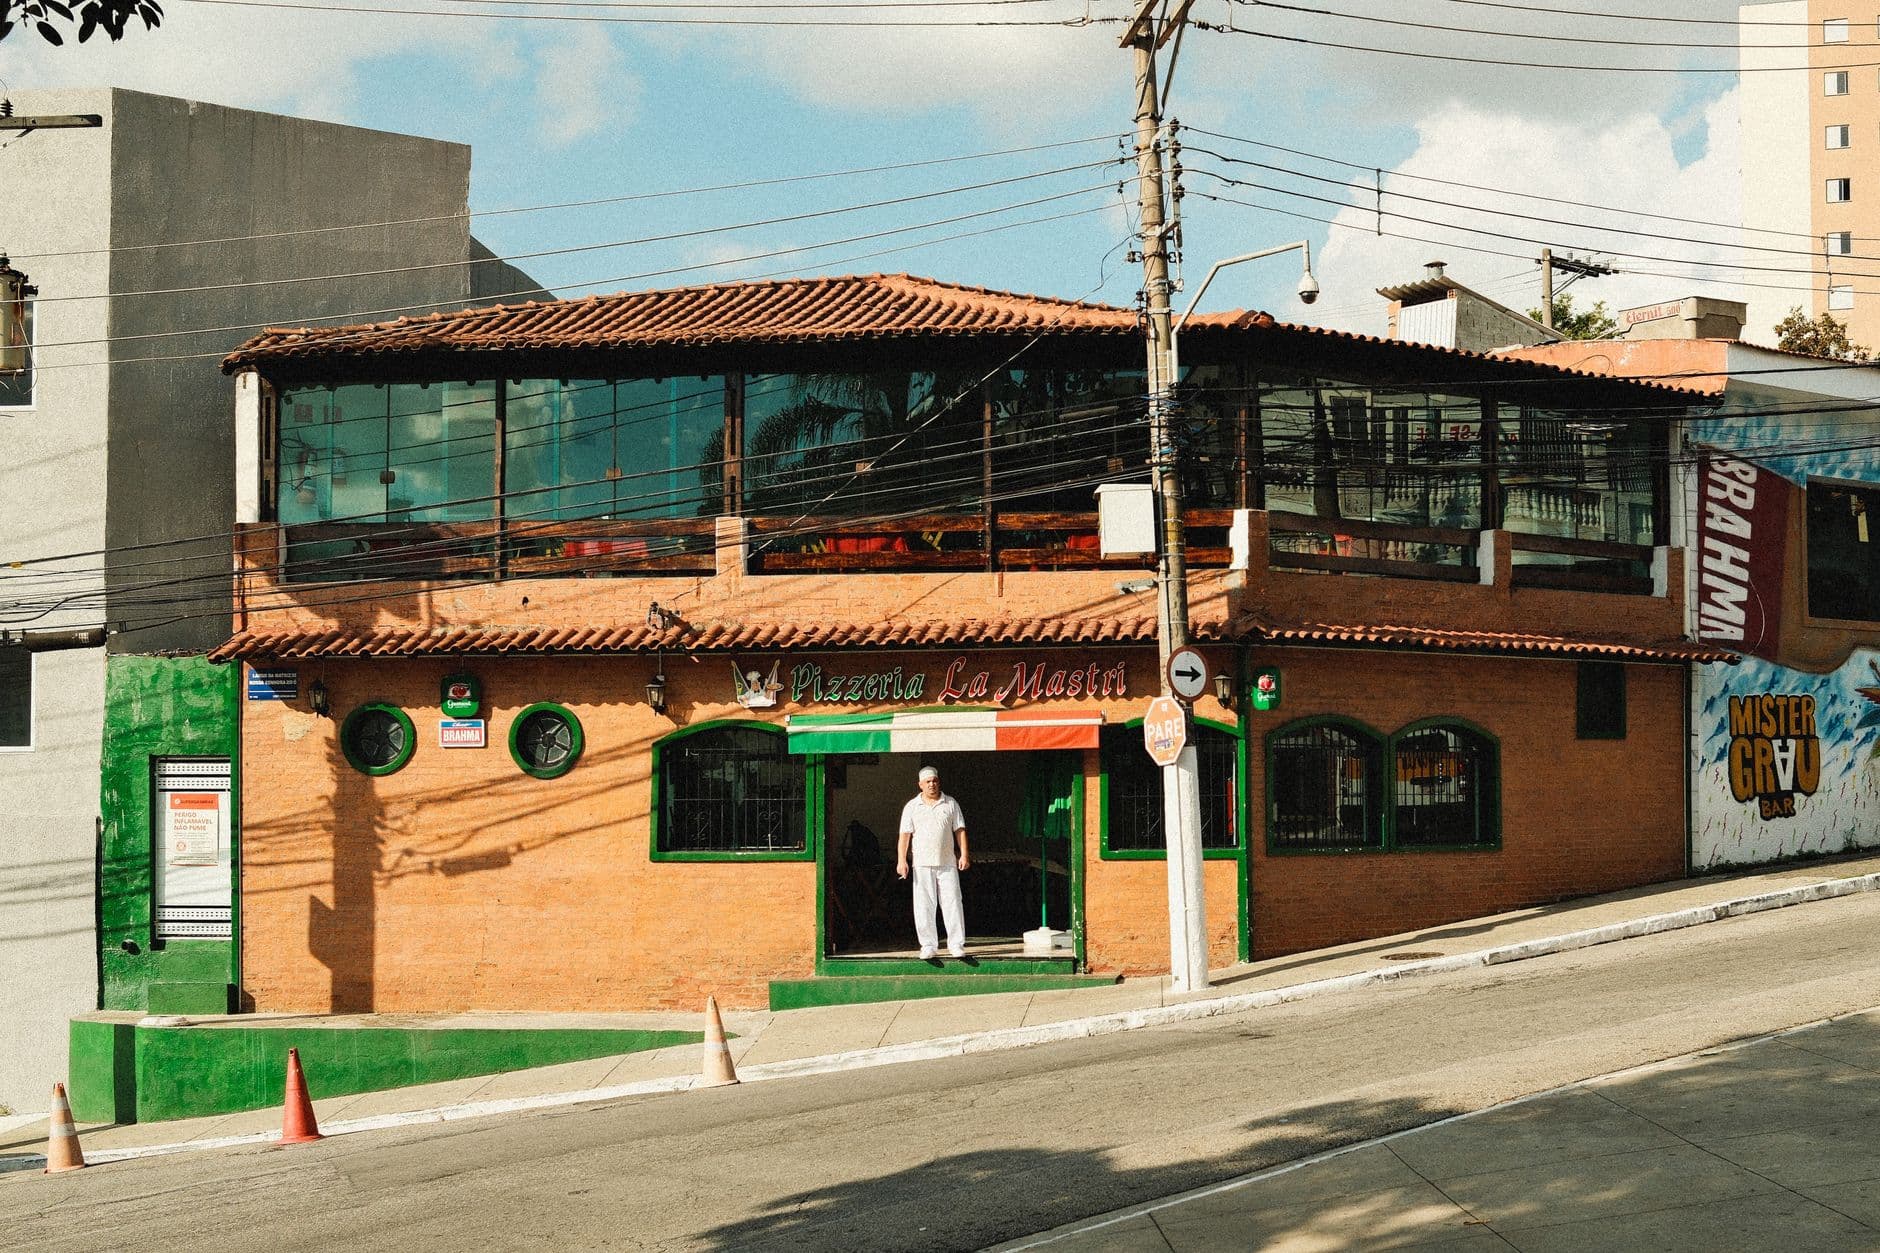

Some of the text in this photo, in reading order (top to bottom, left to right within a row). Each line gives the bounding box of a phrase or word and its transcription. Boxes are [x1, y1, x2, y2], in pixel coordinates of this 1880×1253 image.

[1700, 456, 1757, 641] BRAHMA
[790, 656, 1127, 702] Pizzeria La Mastri
[1147, 717, 1183, 743] PARE
[1728, 693, 1816, 737] MISTER
[443, 729, 481, 742] BRAHMA
[1760, 797, 1795, 818] BAR
